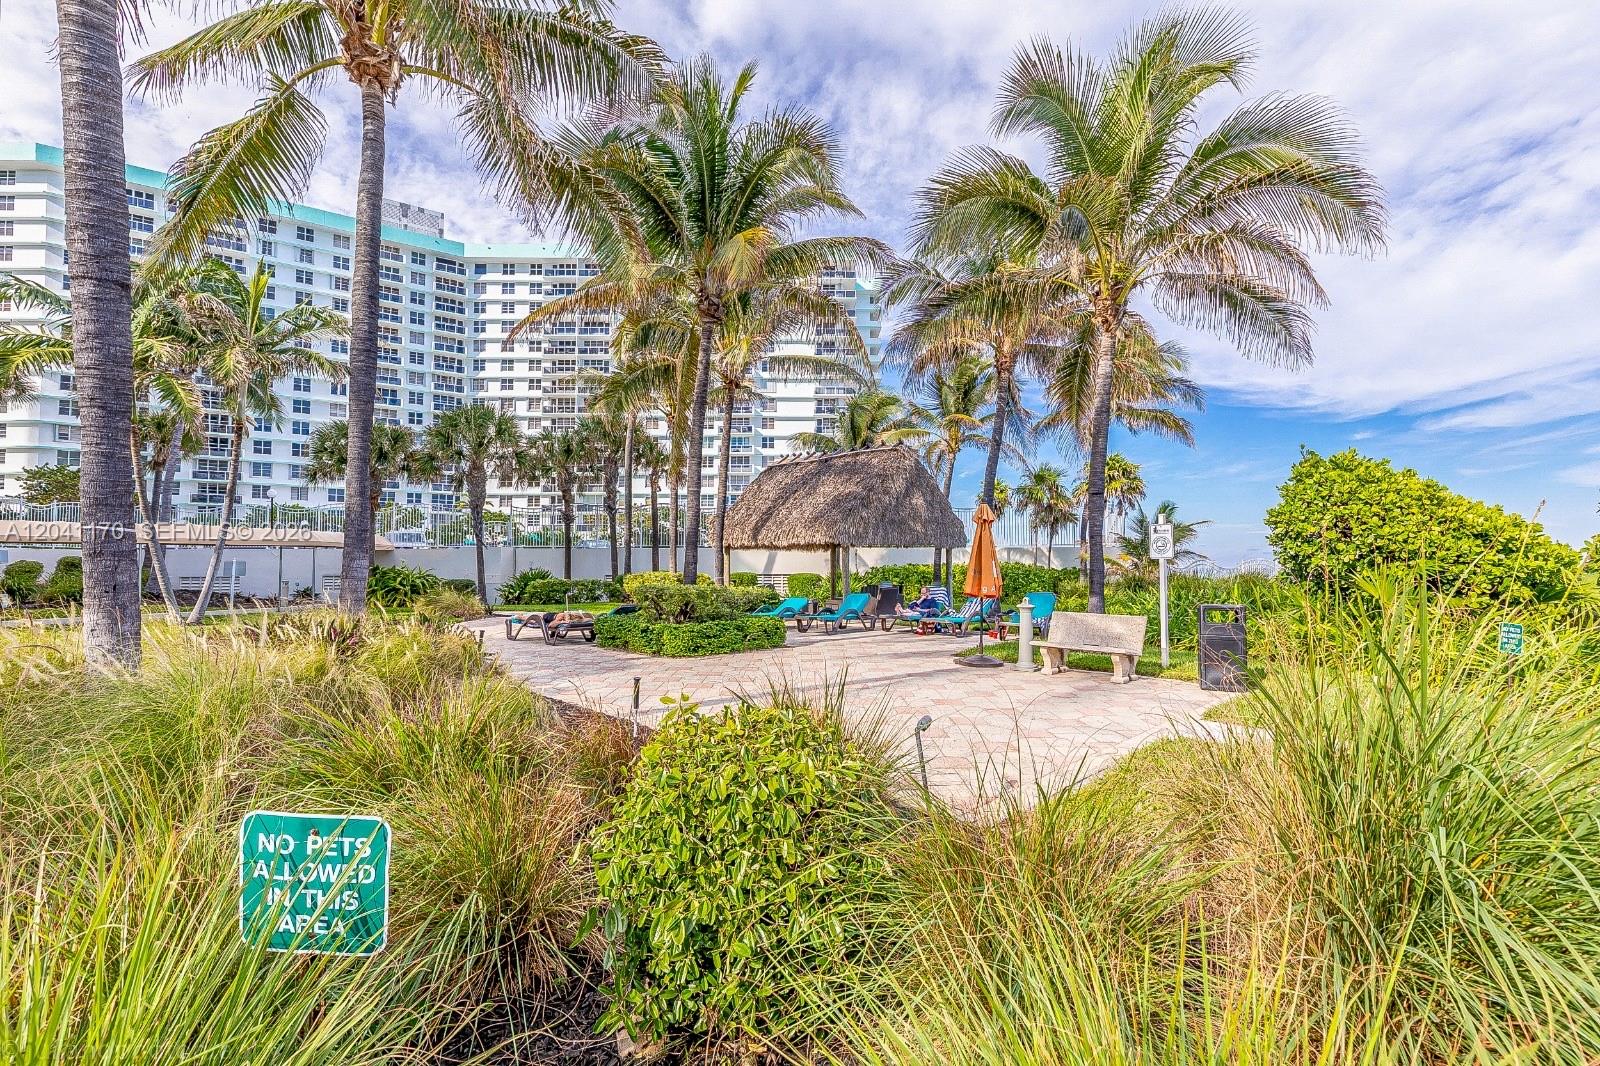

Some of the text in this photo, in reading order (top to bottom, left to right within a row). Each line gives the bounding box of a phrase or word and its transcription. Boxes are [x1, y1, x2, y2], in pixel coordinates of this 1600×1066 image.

[258, 833, 372, 858] NO PETS
[253, 860, 376, 884] ALLOWED
[267, 887, 360, 911] IN THIS
[277, 914, 346, 936] AREA
